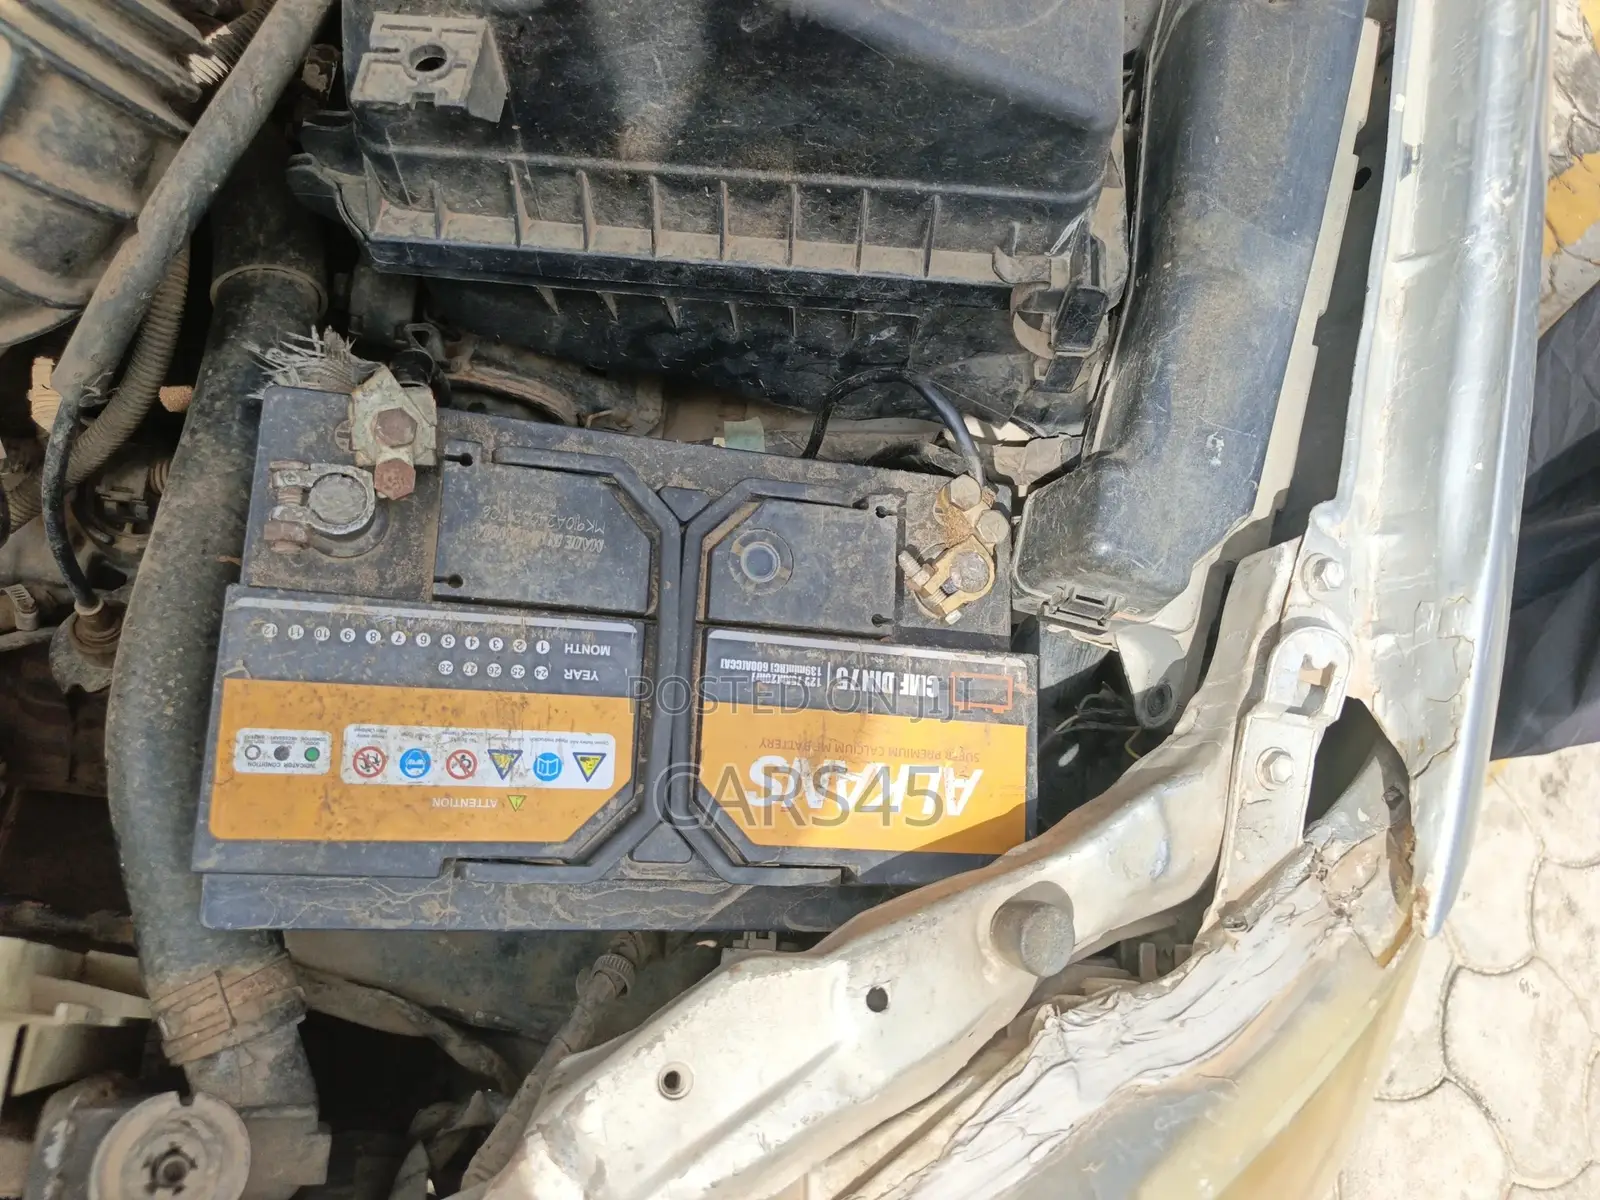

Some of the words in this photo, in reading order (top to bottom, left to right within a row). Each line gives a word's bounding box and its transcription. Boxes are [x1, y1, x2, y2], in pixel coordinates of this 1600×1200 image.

[564, 643, 611, 656] MONTH
[440, 663, 452, 672] 28
[464, 663, 476, 674] 27
[488, 666, 500, 675] 26
[512, 667, 524, 676] 25
[536, 669, 547, 678] 24
[564, 668, 599, 681] YEAR
[759, 738, 810, 752] BATTERY
[836, 743, 884, 757] CALCIUM
[892, 748, 940, 761] PREMIUM
[432, 797, 498, 809] ATTENTION
